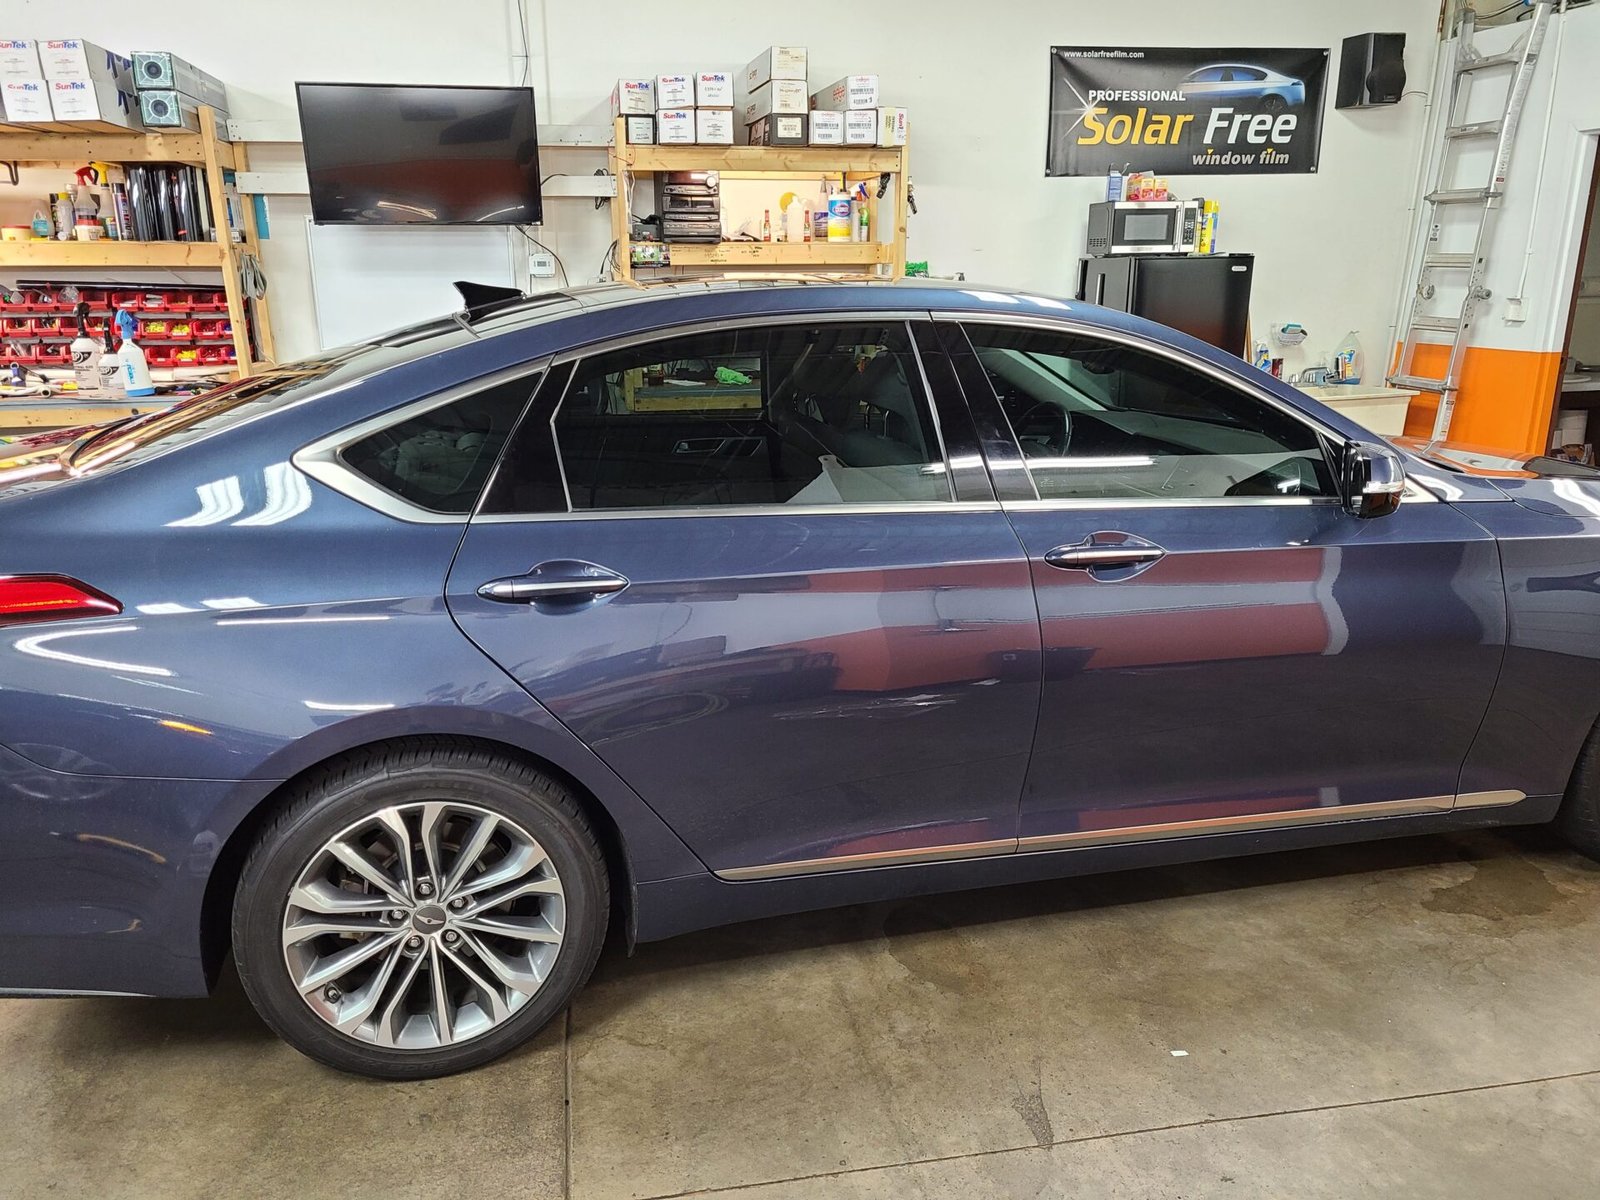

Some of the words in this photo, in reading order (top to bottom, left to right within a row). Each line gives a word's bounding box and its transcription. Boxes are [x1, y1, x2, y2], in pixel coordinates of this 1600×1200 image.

[47, 41, 78, 49] SunTek
[1063, 50, 1145, 58] www.solarfreefilm.com
[7, 83, 39, 91] SunTek
[55, 82, 86, 90] SunTek
[1088, 89, 1186, 102] PROFESSIONAL
[1077, 107, 1195, 146] Solar
[1202, 107, 1298, 145] Free
[1192, 148, 1256, 166] window
[1259, 148, 1290, 165] film
